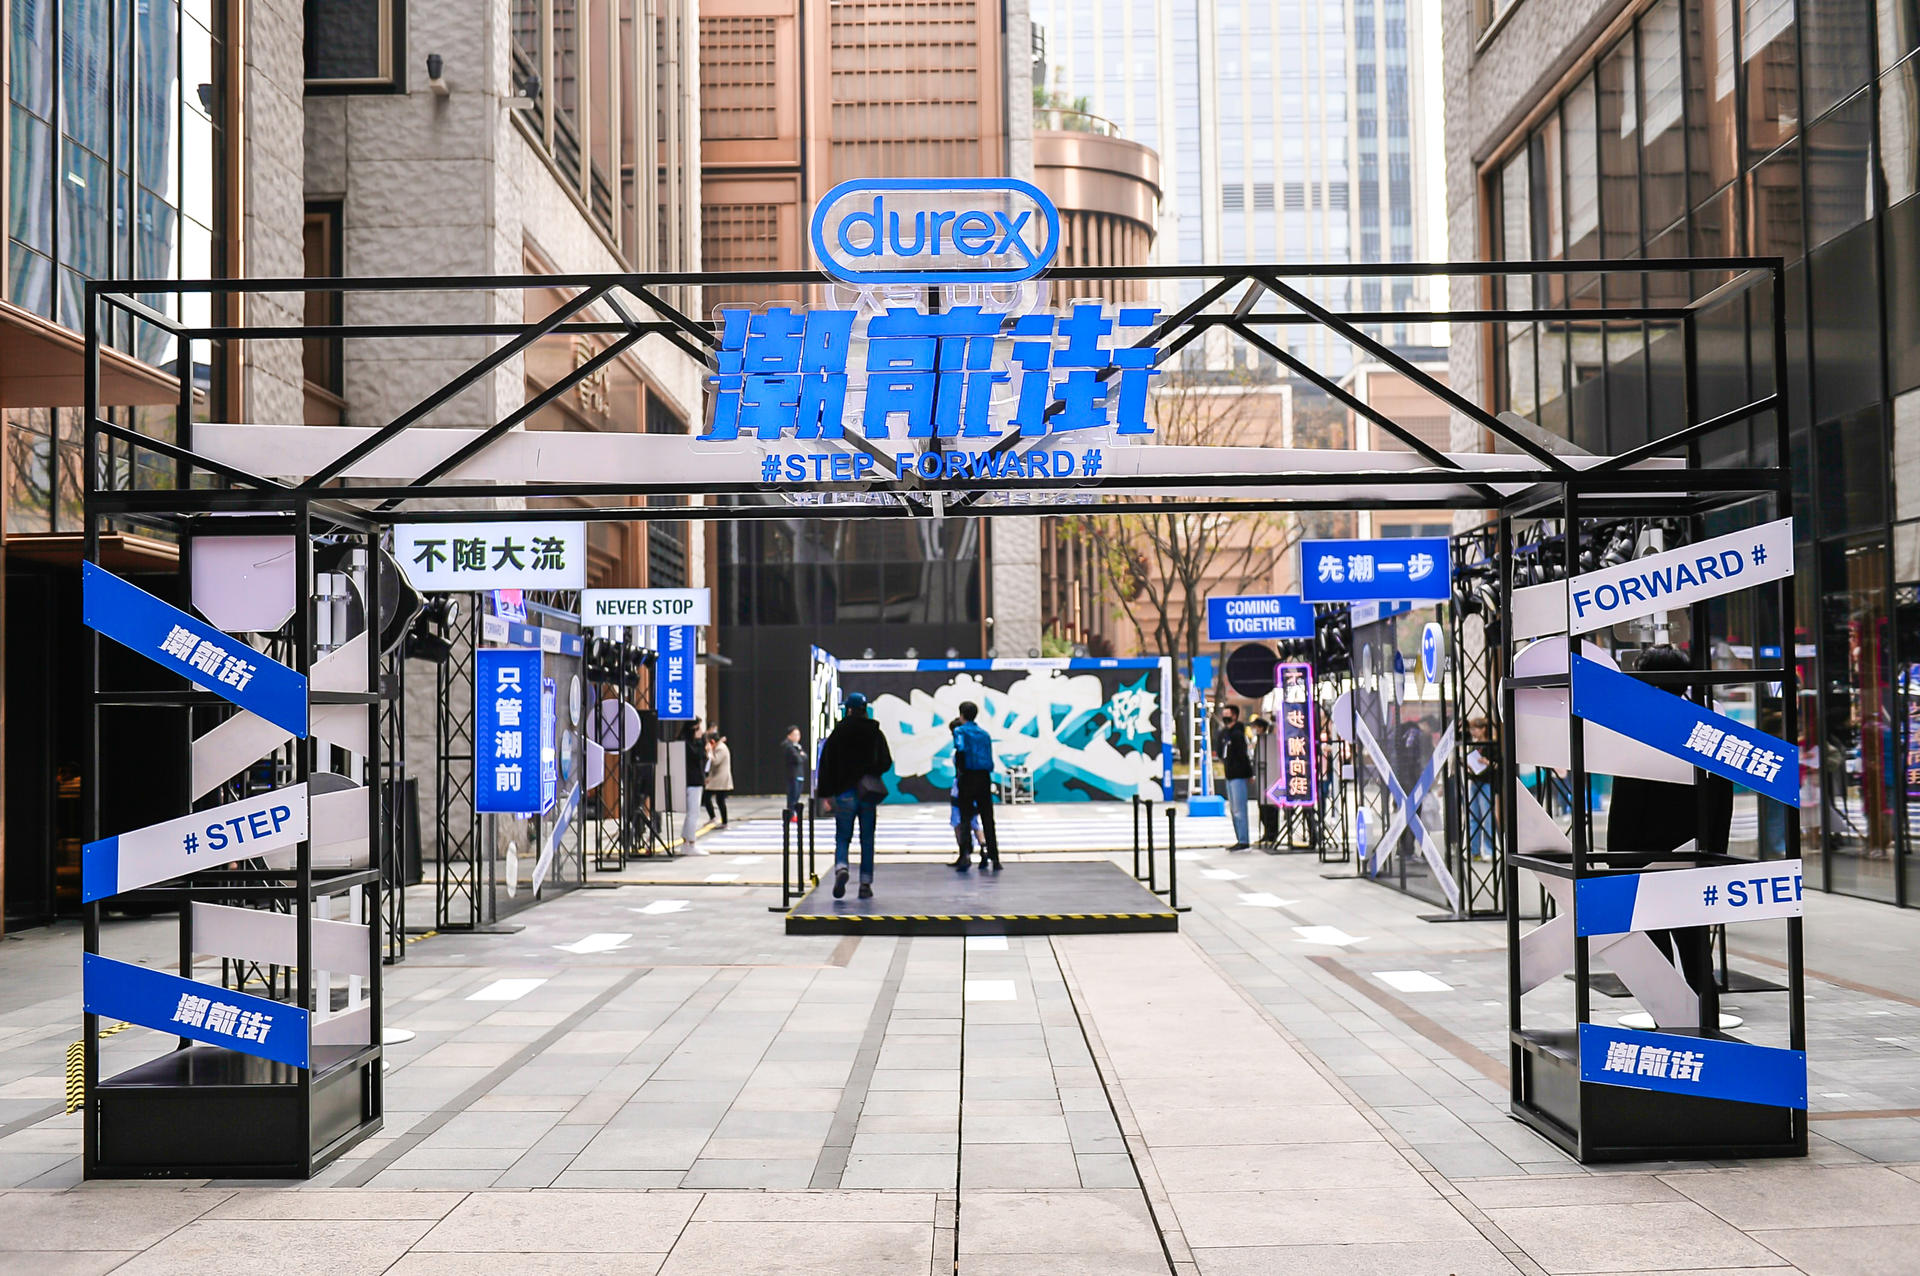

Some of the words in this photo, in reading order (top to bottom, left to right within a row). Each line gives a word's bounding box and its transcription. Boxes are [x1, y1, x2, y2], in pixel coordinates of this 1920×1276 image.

[838, 196, 1034, 259] durex
[696, 305, 1161, 441] 潮前街
[413, 536, 566, 572] 不随大流
[1318, 553, 1433, 583] 先潮一步
[596, 600, 647, 615] NEVER
[652, 599, 693, 615] STOP
[1226, 599, 1280, 615] COMING
[1226, 616, 1296, 633] TOGETHER
[158, 624, 257, 692] 潮前街
[669, 656, 682, 682] THE
[668, 688, 682, 714] OFF
[495, 667, 522, 792] 只管潮前
[1682, 721, 1785, 783] 潮前街
[170, 993, 274, 1044] 潮前街
[1602, 1041, 1705, 1082] 潮前街
